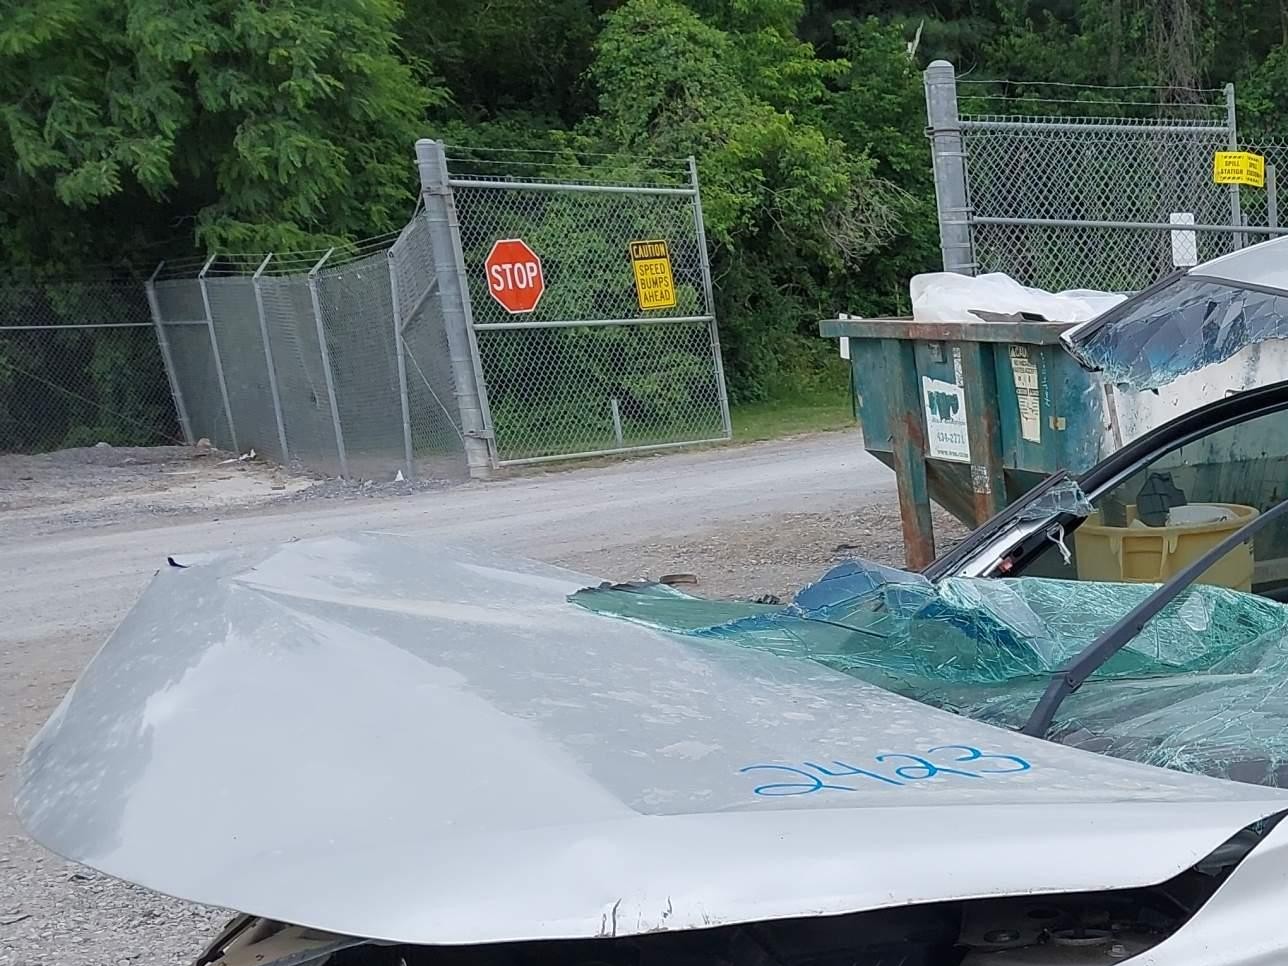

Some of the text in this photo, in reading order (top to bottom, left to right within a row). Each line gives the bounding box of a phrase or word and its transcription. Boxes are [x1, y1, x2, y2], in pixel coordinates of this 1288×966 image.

[633, 243, 666, 258] CAUTION
[491, 262, 538, 291] STOP
[638, 263, 666, 276] SPEED
[640, 276, 669, 291] BUMPS
[643, 290, 671, 304] AHEAD
[740, 745, 1031, 796] 2423
